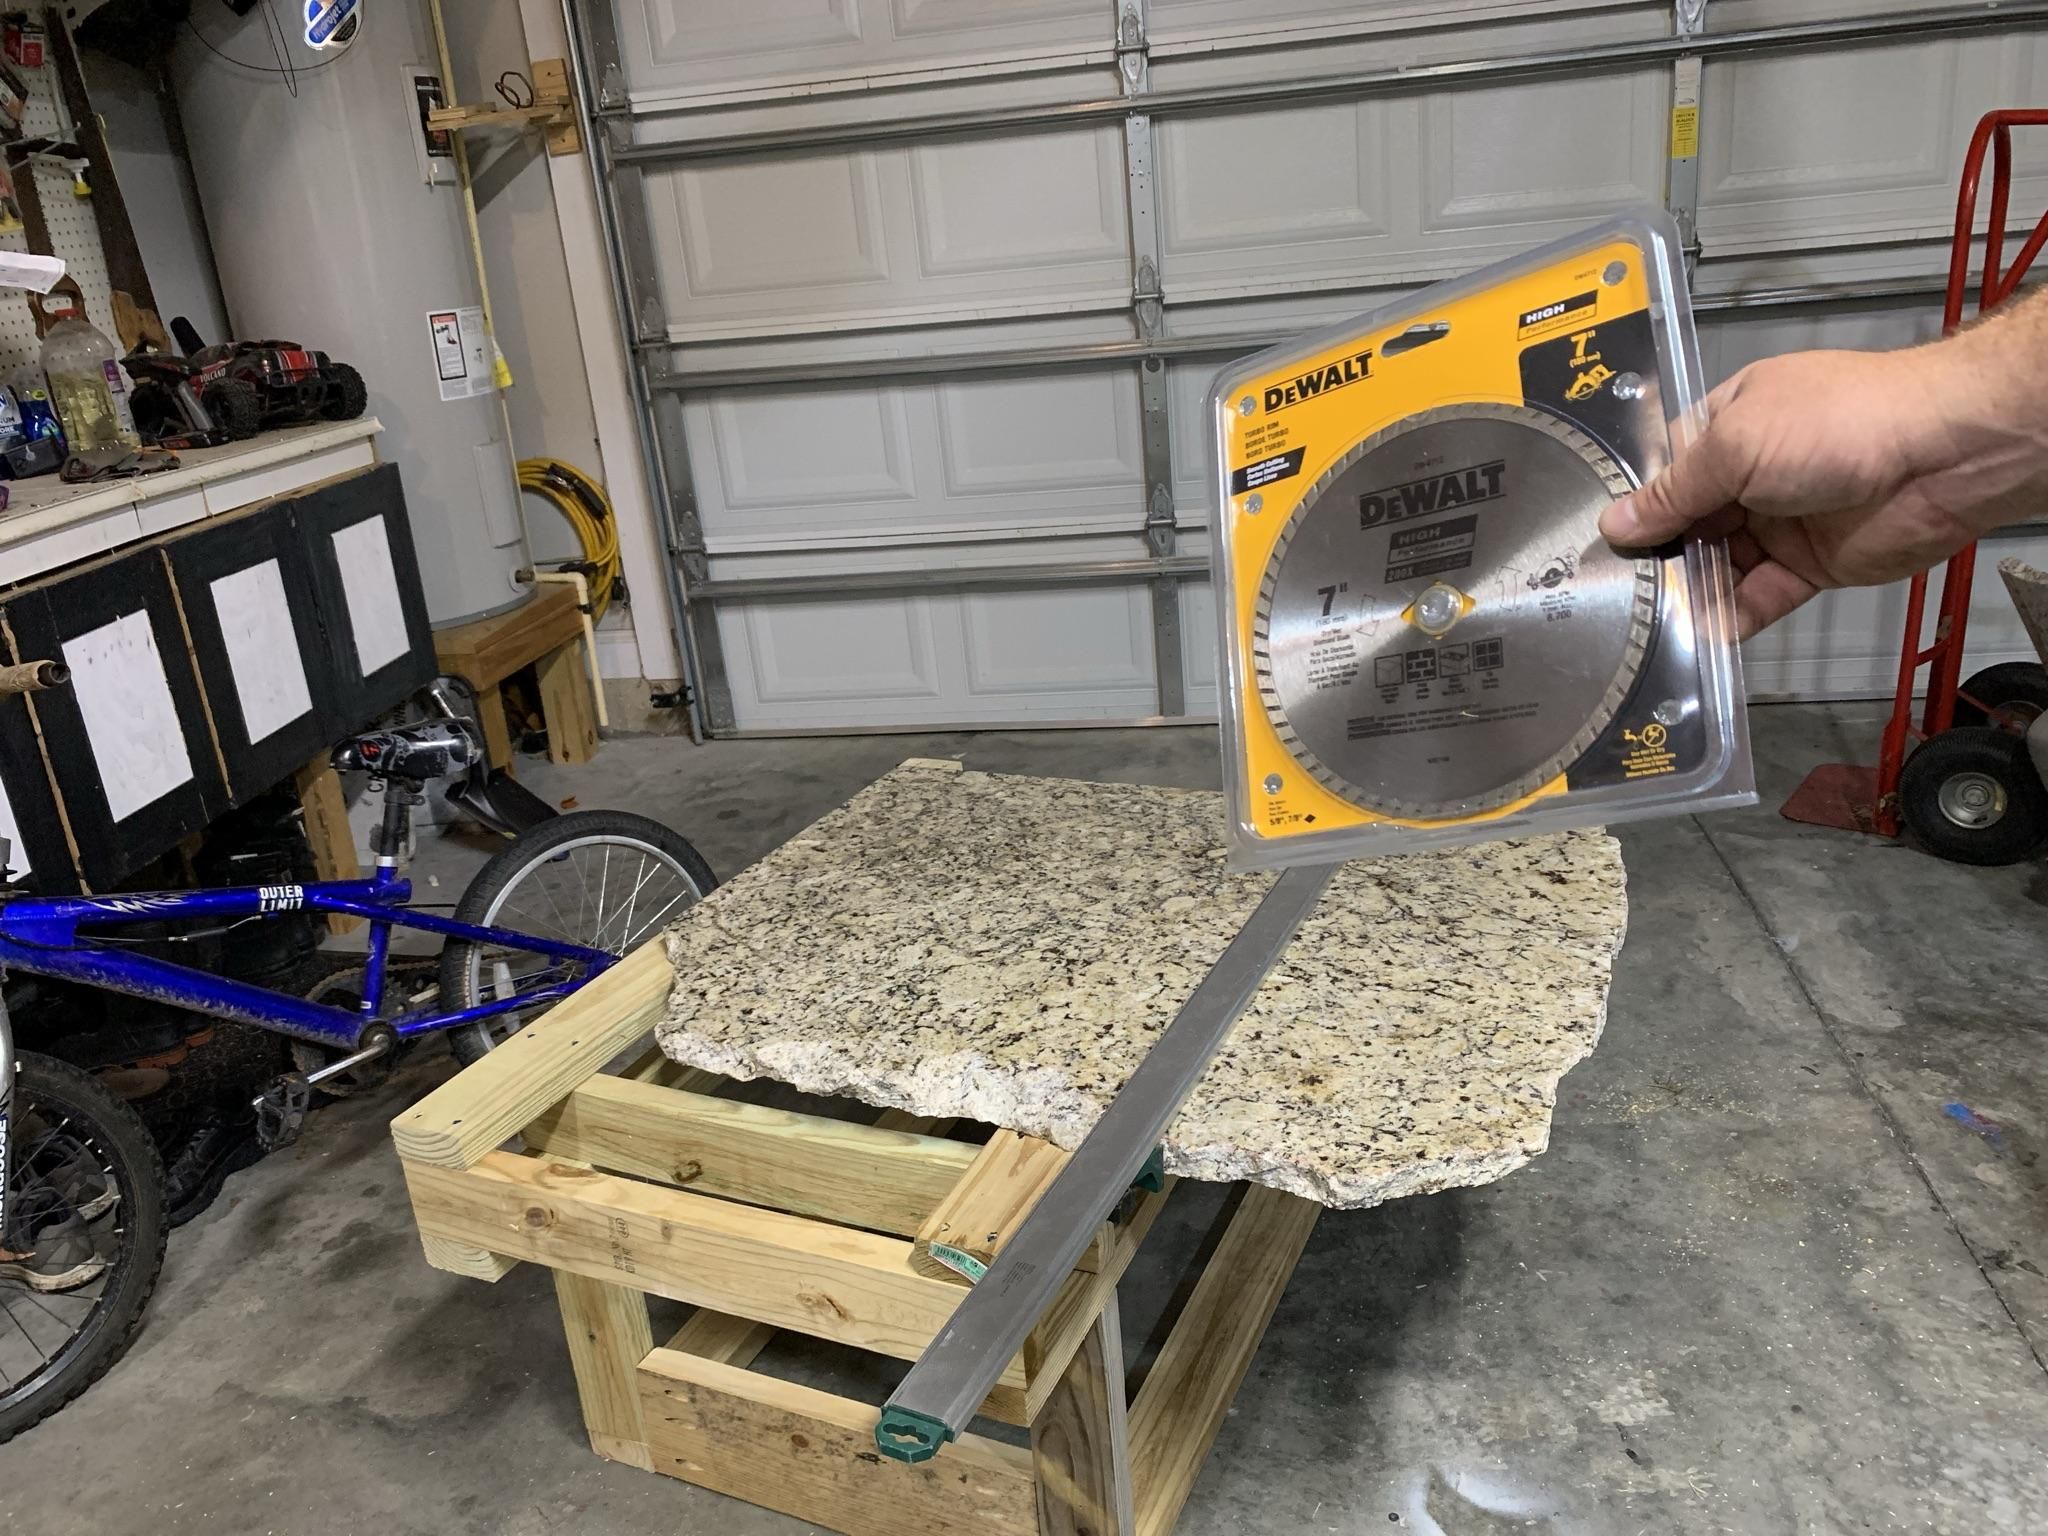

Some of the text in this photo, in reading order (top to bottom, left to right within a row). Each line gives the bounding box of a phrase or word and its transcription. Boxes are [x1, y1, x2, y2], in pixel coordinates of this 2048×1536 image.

[1526, 304, 1565, 323] HIGH
[200, 368, 226, 383] VOLCANO
[1265, 351, 1373, 412] DEWALT
[1360, 463, 1505, 526] DEWALT
[1399, 527, 1441, 545] HIGH
[259, 885, 303, 899] OUTER
[260, 898, 303, 912] LIMIT
